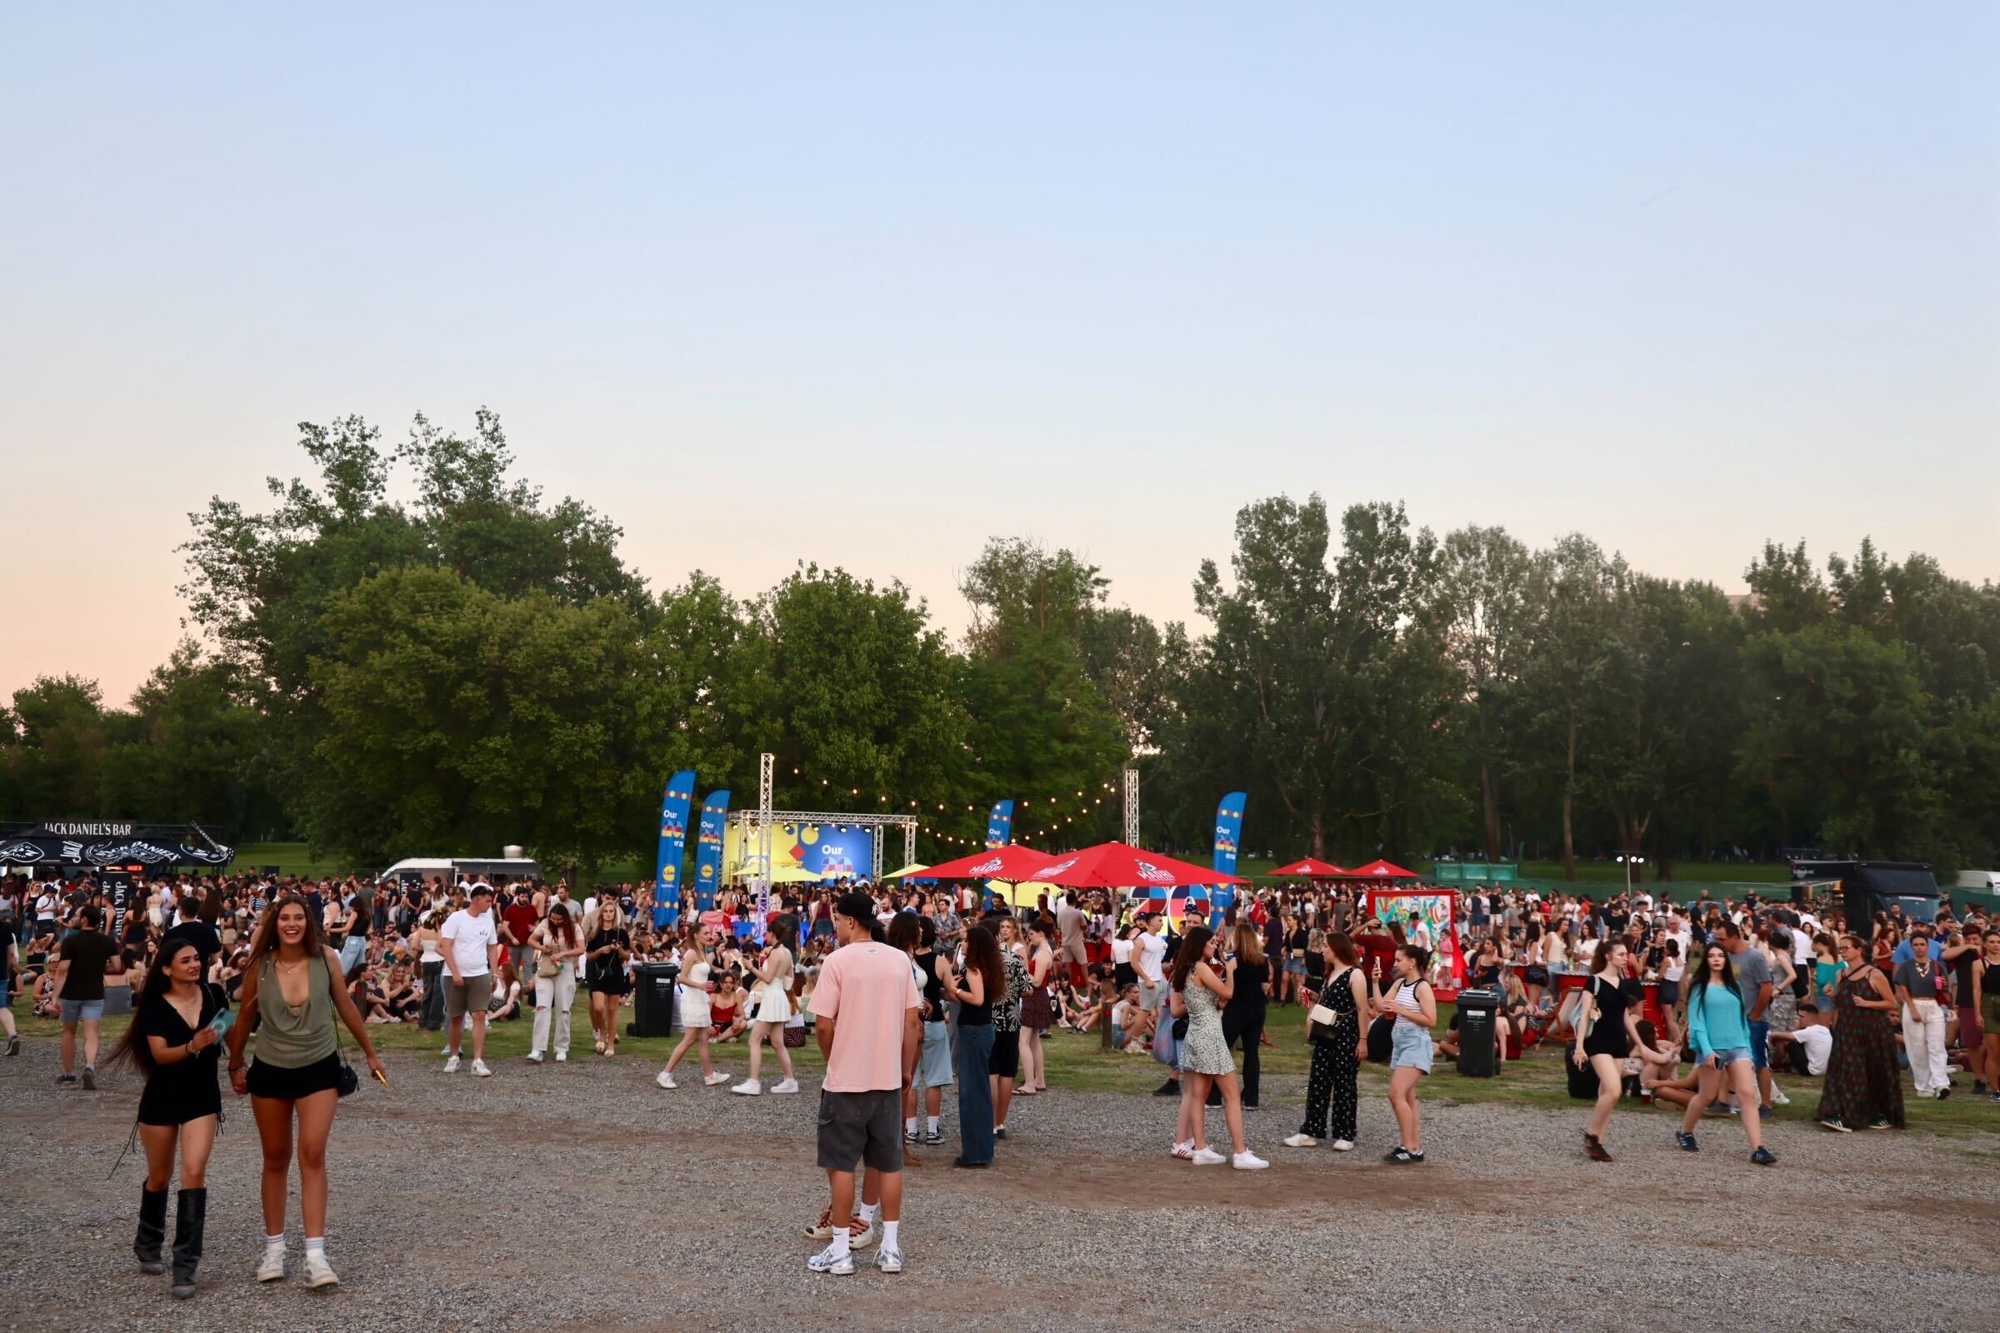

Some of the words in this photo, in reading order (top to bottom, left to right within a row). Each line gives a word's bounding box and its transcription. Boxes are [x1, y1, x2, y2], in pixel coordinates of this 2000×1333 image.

[663, 809, 678, 819] Our
[69, 822, 111, 835] DANIEL'S
[112, 824, 132, 836] BAR
[988, 828, 1001, 836] Our
[1216, 826, 1231, 834] Our
[821, 844, 844, 855] Our
[114, 881, 128, 905] JACK
